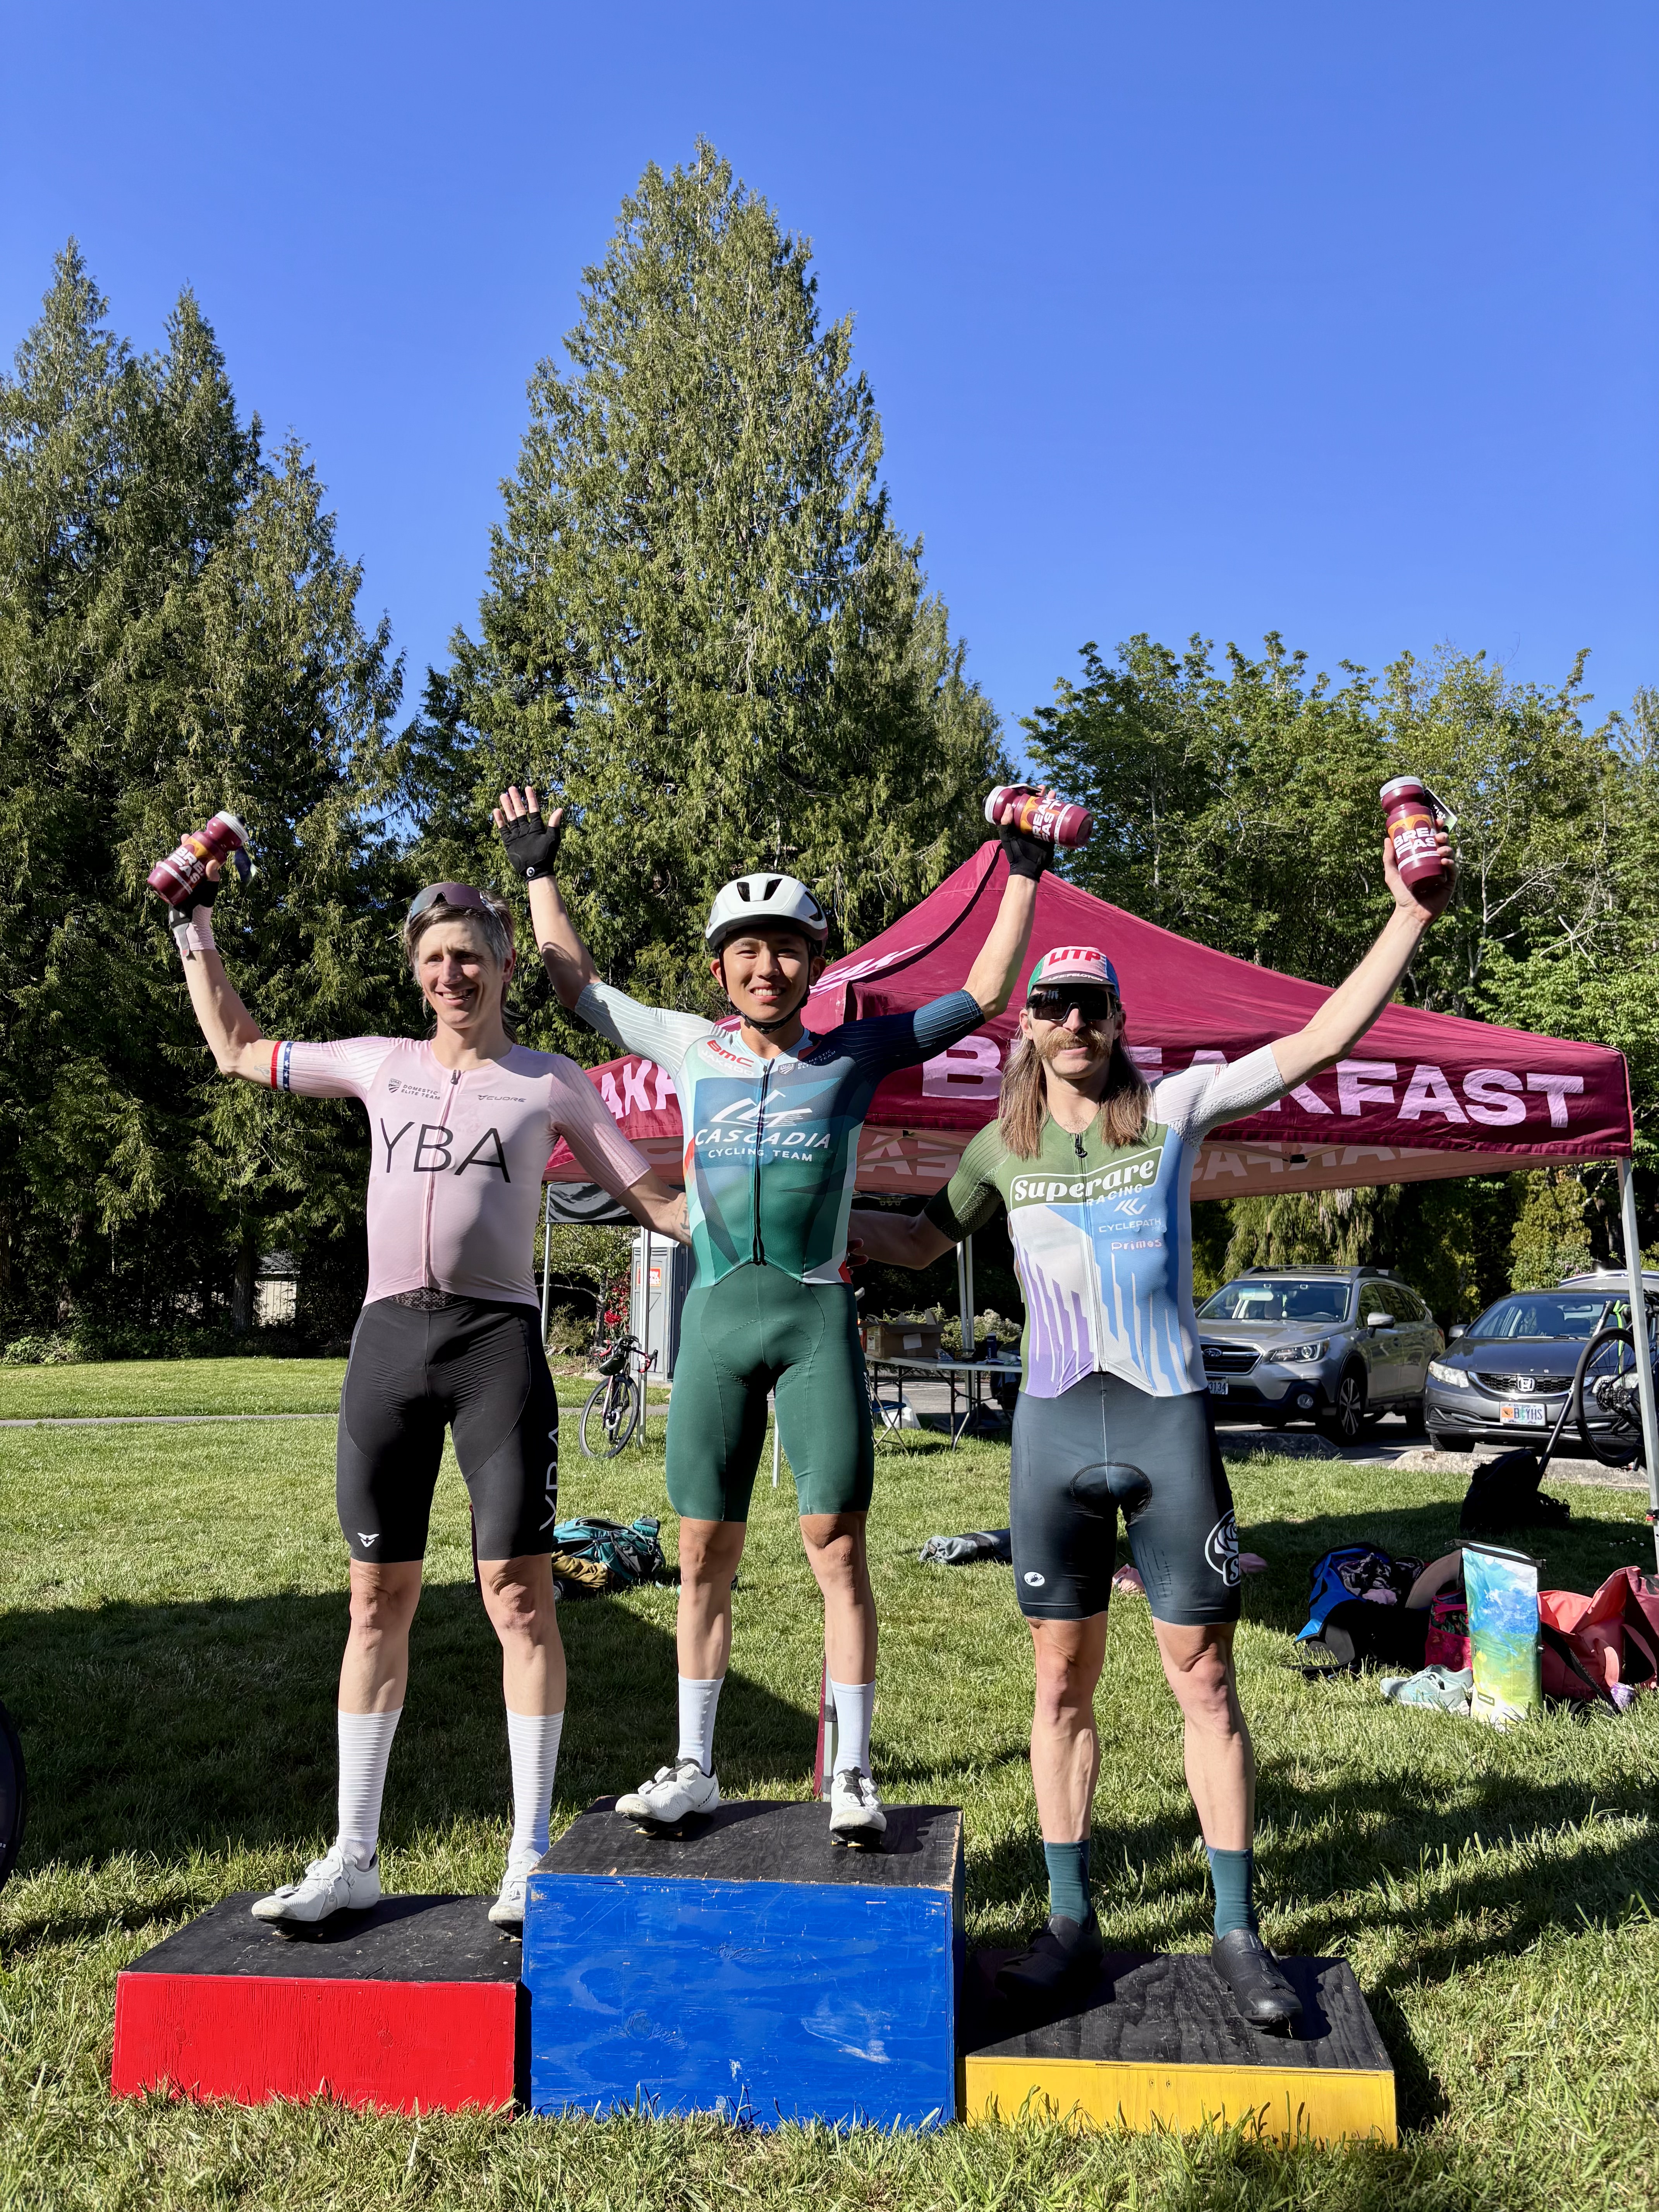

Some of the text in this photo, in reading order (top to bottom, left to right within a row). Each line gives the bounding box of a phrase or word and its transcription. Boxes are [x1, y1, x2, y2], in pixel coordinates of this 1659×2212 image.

[1393, 827, 1437, 850] BREA
[1396, 837, 1436, 859] FAS
[168, 854, 200, 883] FAS
[175, 847, 205, 875] BRE
[1049, 949, 1101, 966] LITP
[707, 1040, 754, 1067] BMC
[798, 1049, 831, 1066] DOMESTIC
[820, 1051, 836, 1061] TEAM
[403, 1084, 438, 1095] DOMESTIC
[695, 1128, 831, 1149] CASCADIA
[380, 1118, 511, 1183] YBA
[708, 1147, 812, 1161] CYCLING TEAM
[1014, 1160, 1154, 1201] Superare
[1086, 1183, 1143, 1206] RACING
[1099, 1218, 1161, 1233] CYCLEPATH
[1209, 1382, 1226, 1392] 3134
